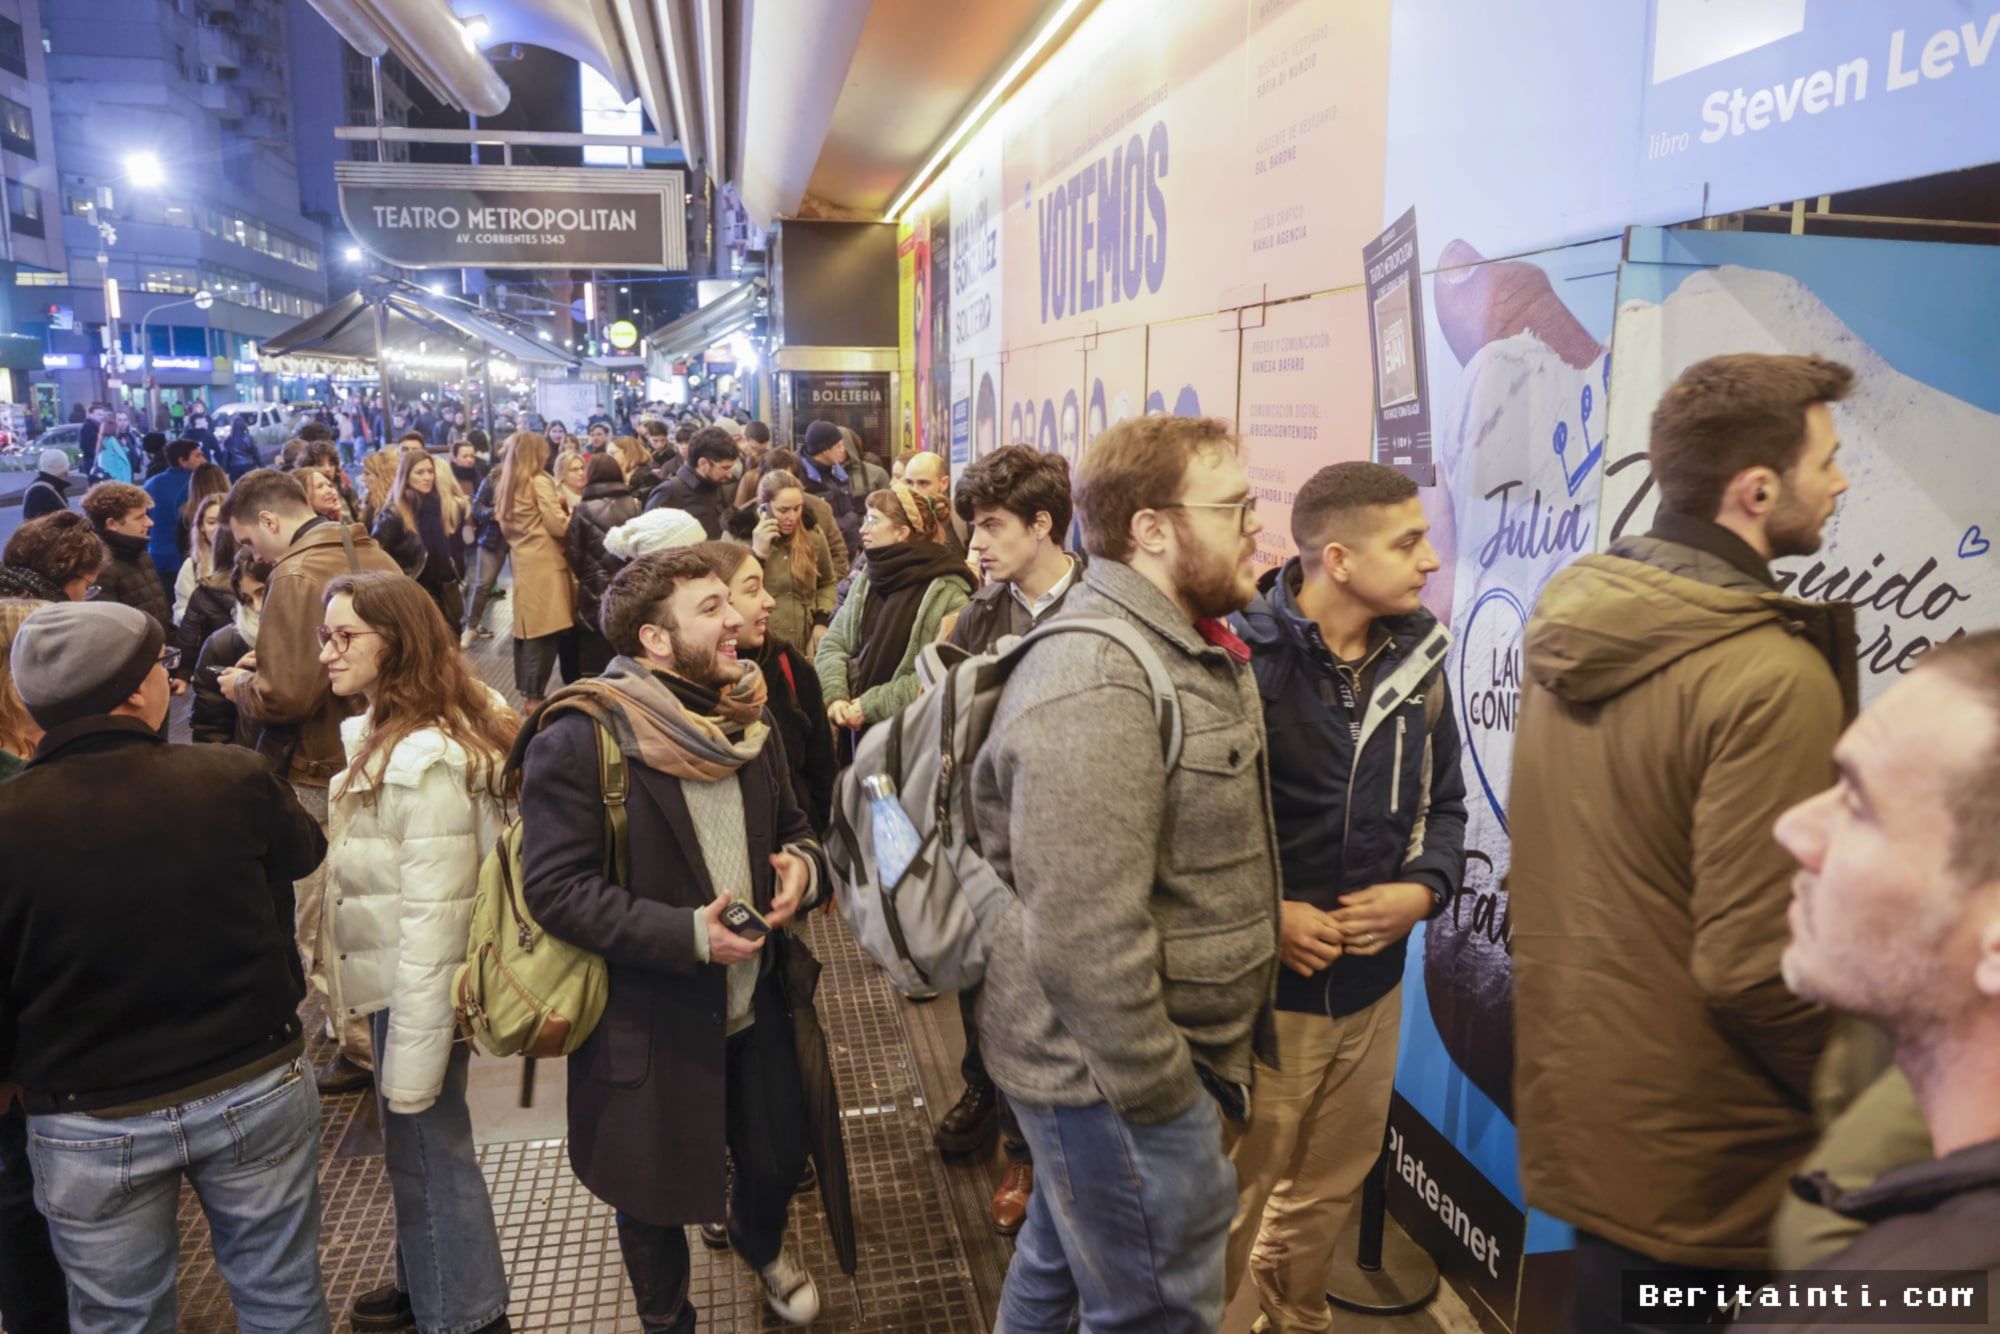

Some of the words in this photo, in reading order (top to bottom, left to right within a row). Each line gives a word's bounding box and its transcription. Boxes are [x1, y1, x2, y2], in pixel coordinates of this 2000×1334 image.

[1279, 70, 1287, 88] DI
[1288, 52, 1317, 81] NUNZIO
[1280, 45, 1290, 65] DE
[1649, 131, 1689, 160] libro
[1699, 57, 1868, 143] Steven
[1886, 12, 2000, 92] Lev
[1288, 121, 1297, 142] DE
[1256, 160, 1268, 177] SOL
[1269, 145, 1297, 170] BARONE
[373, 206, 460, 229] TEATRO
[468, 207, 636, 231] METROPOLITAN
[1038, 120, 1169, 324] VOTEMOS
[456, 234, 473, 245] AV.
[476, 234, 538, 245] CORRIENTES
[540, 234, 566, 245] 1343
[1276, 225, 1307, 246] AGENCIA
[1369, 262, 1384, 285] TEATRO
[1384, 240, 1414, 275] METROPOLITAN
[956, 293, 991, 344] SOLTERO
[1252, 340, 1273, 353] PRENSA
[1384, 335, 1407, 374] EVAN
[1252, 359, 1276, 374] VANESA
[1278, 357, 1304, 371] BAFARO
[1479, 480, 1590, 569] Julia
